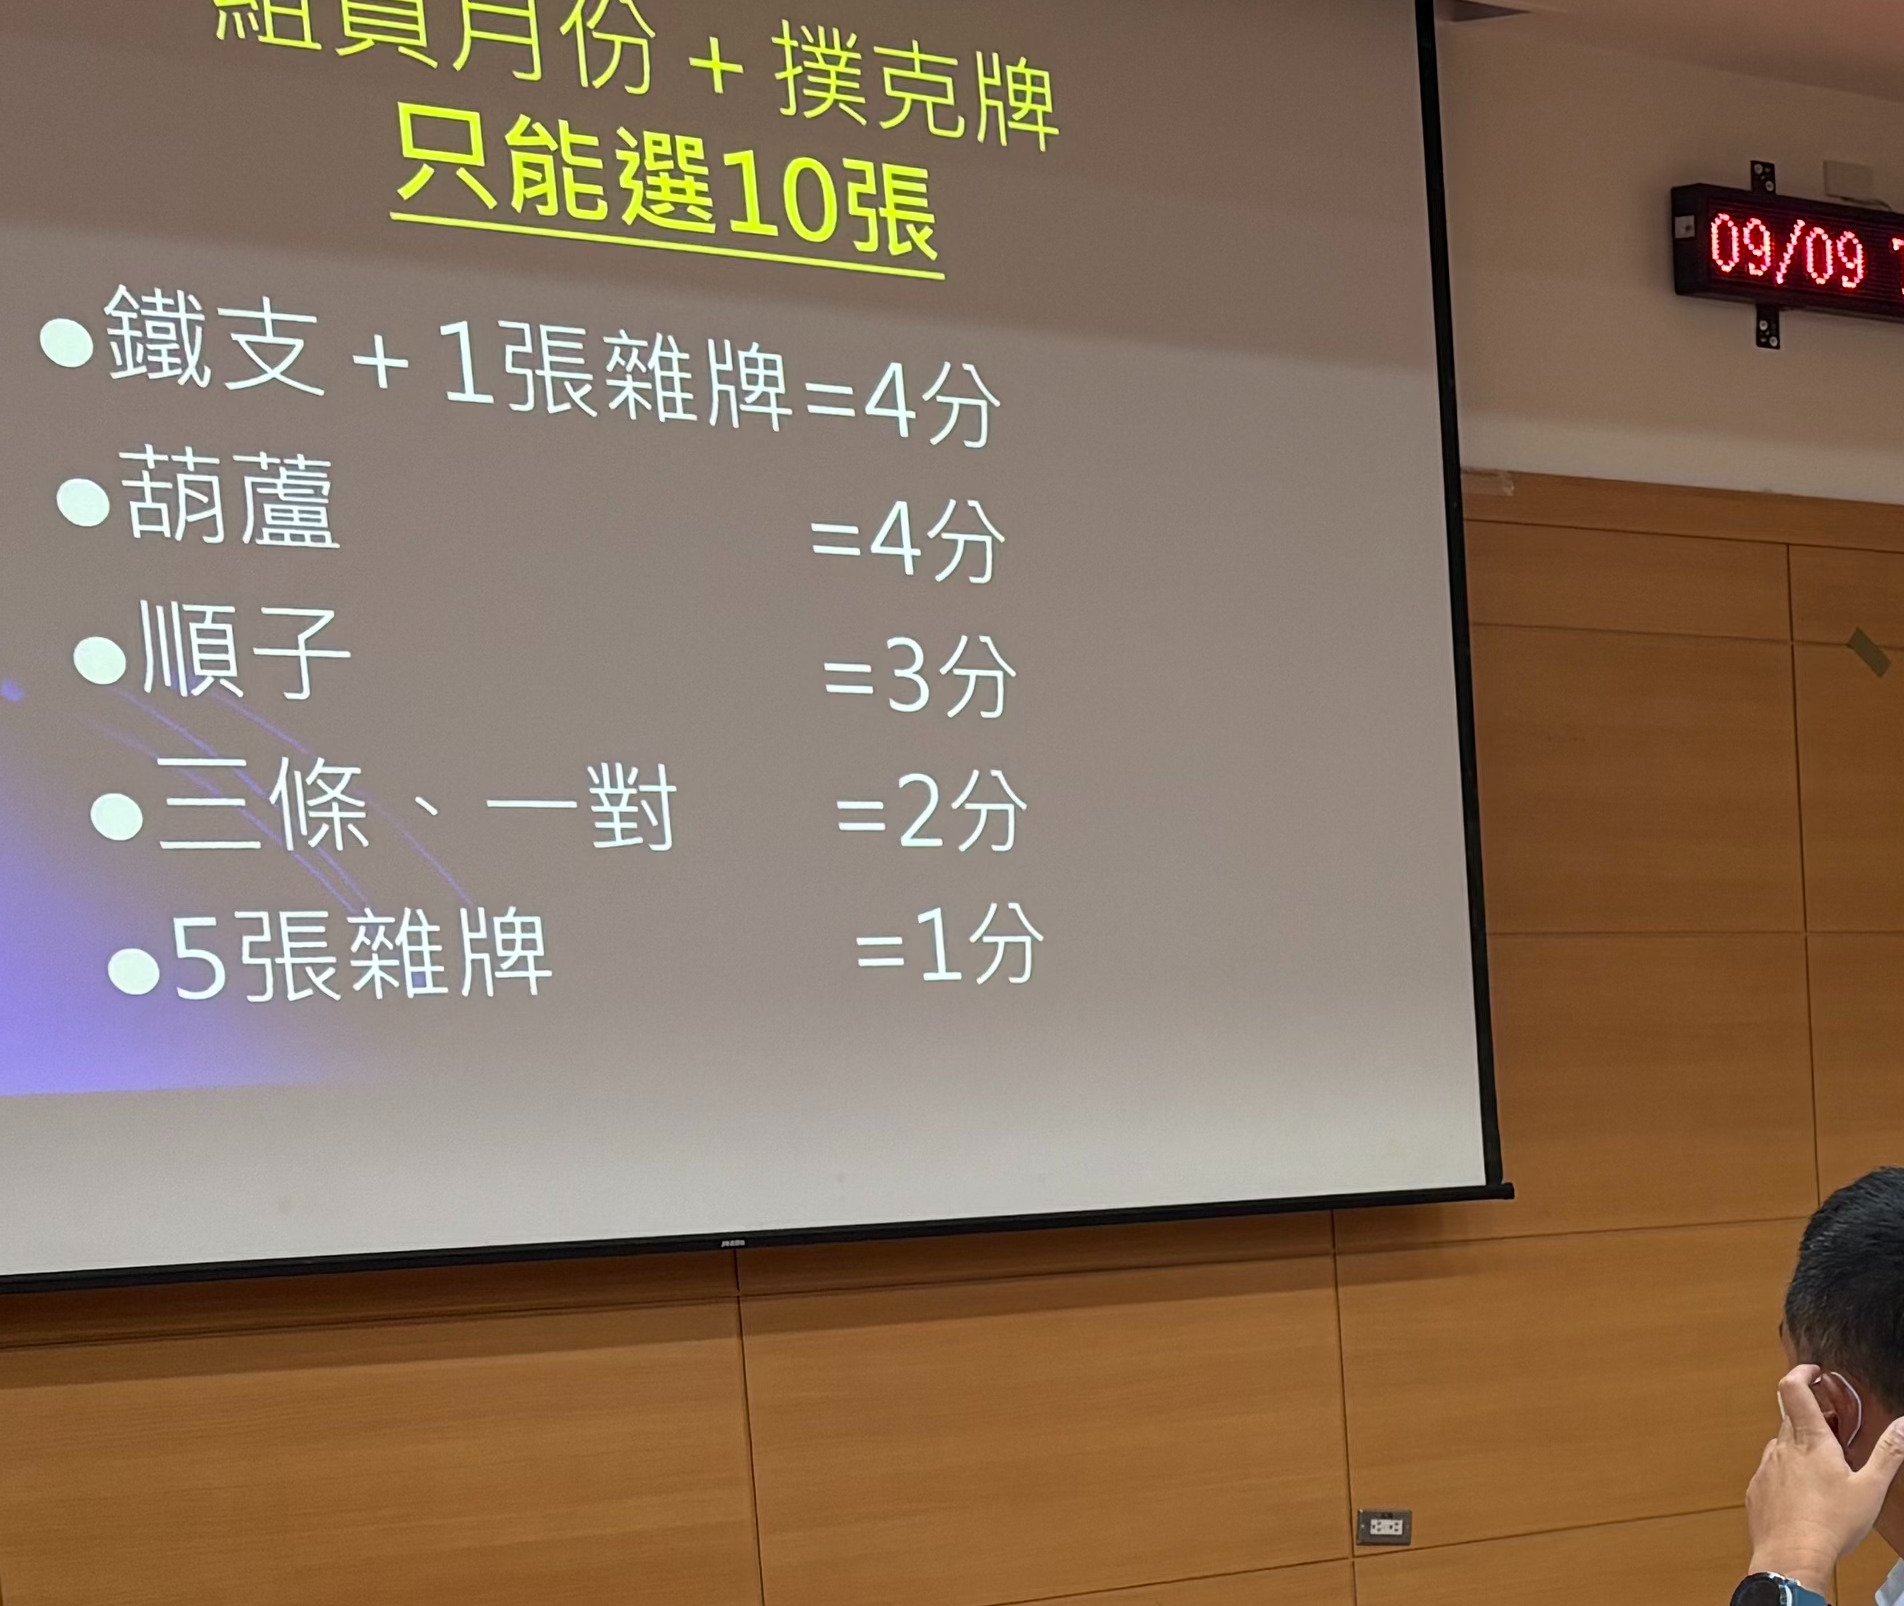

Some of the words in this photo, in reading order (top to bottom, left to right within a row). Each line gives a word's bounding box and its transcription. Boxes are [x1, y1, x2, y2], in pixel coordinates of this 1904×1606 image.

[395, 101, 940, 262] 只能選10張
[1709, 212, 1867, 289] 09/09
[118, 443, 341, 549] 葫蘆
[810, 498, 1006, 585] =4分
[140, 598, 352, 701] 順子
[822, 634, 1017, 720] =3分
[156, 756, 678, 856] 三條、一對
[835, 769, 1028, 853] =2分
[172, 905, 553, 1005] 5張雜牌
[855, 901, 1045, 986] =1分
